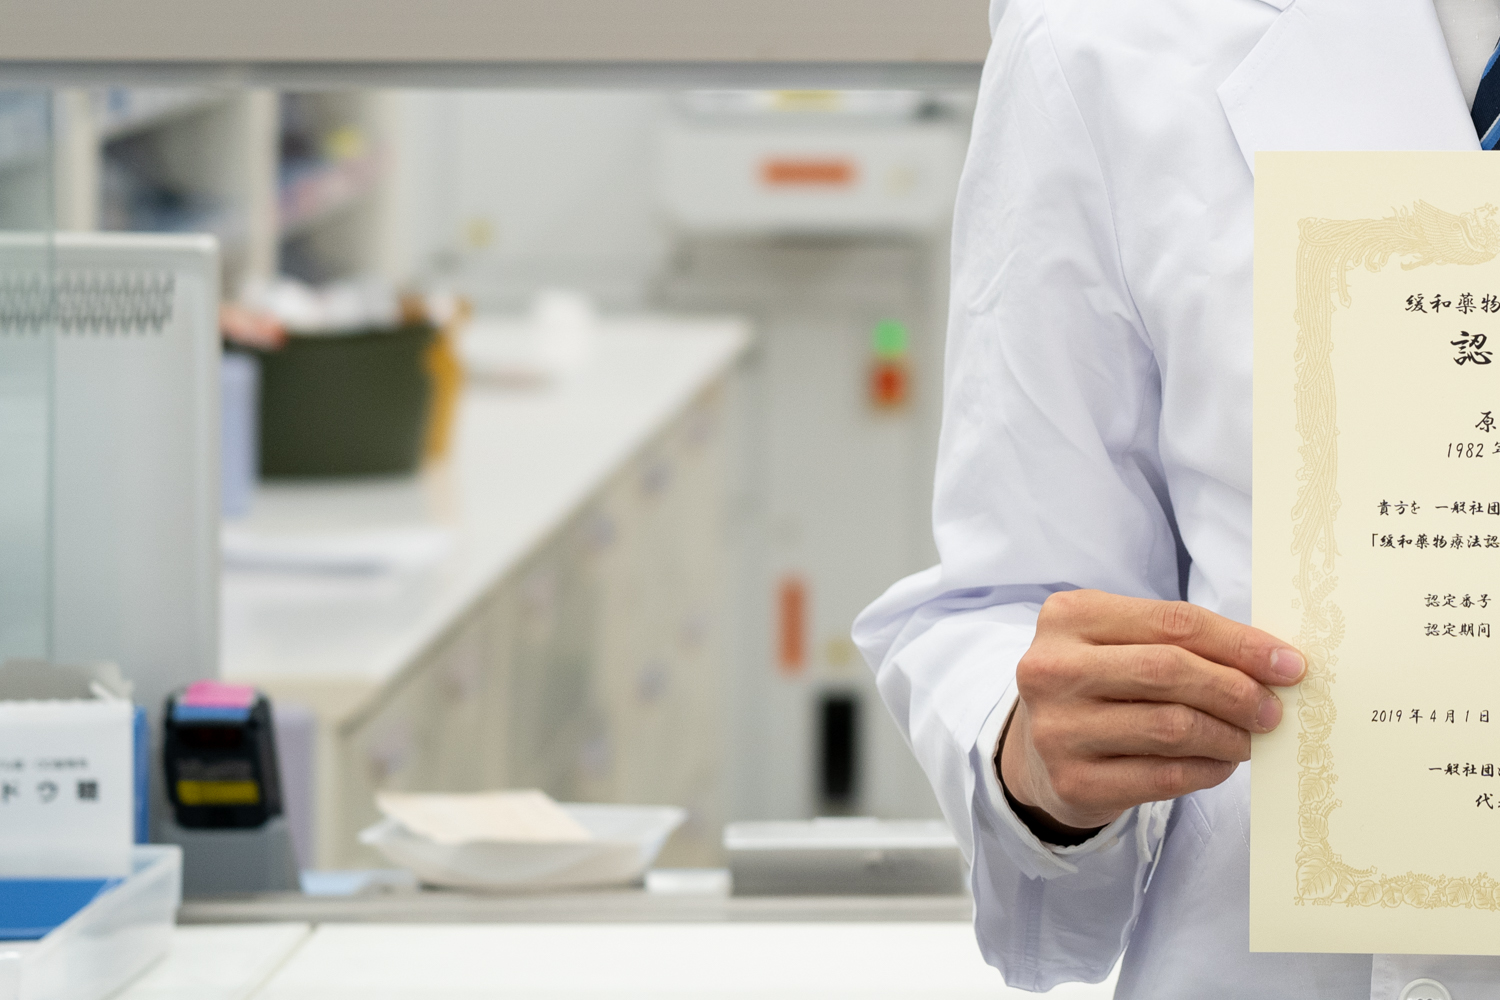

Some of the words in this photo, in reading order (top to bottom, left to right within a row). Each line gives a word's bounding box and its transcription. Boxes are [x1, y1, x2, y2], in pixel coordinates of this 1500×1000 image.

[1377, 499, 1421, 516] 貴方を
[1424, 593, 1492, 609] 認定番号
[1423, 622, 1491, 639] 認定期間
